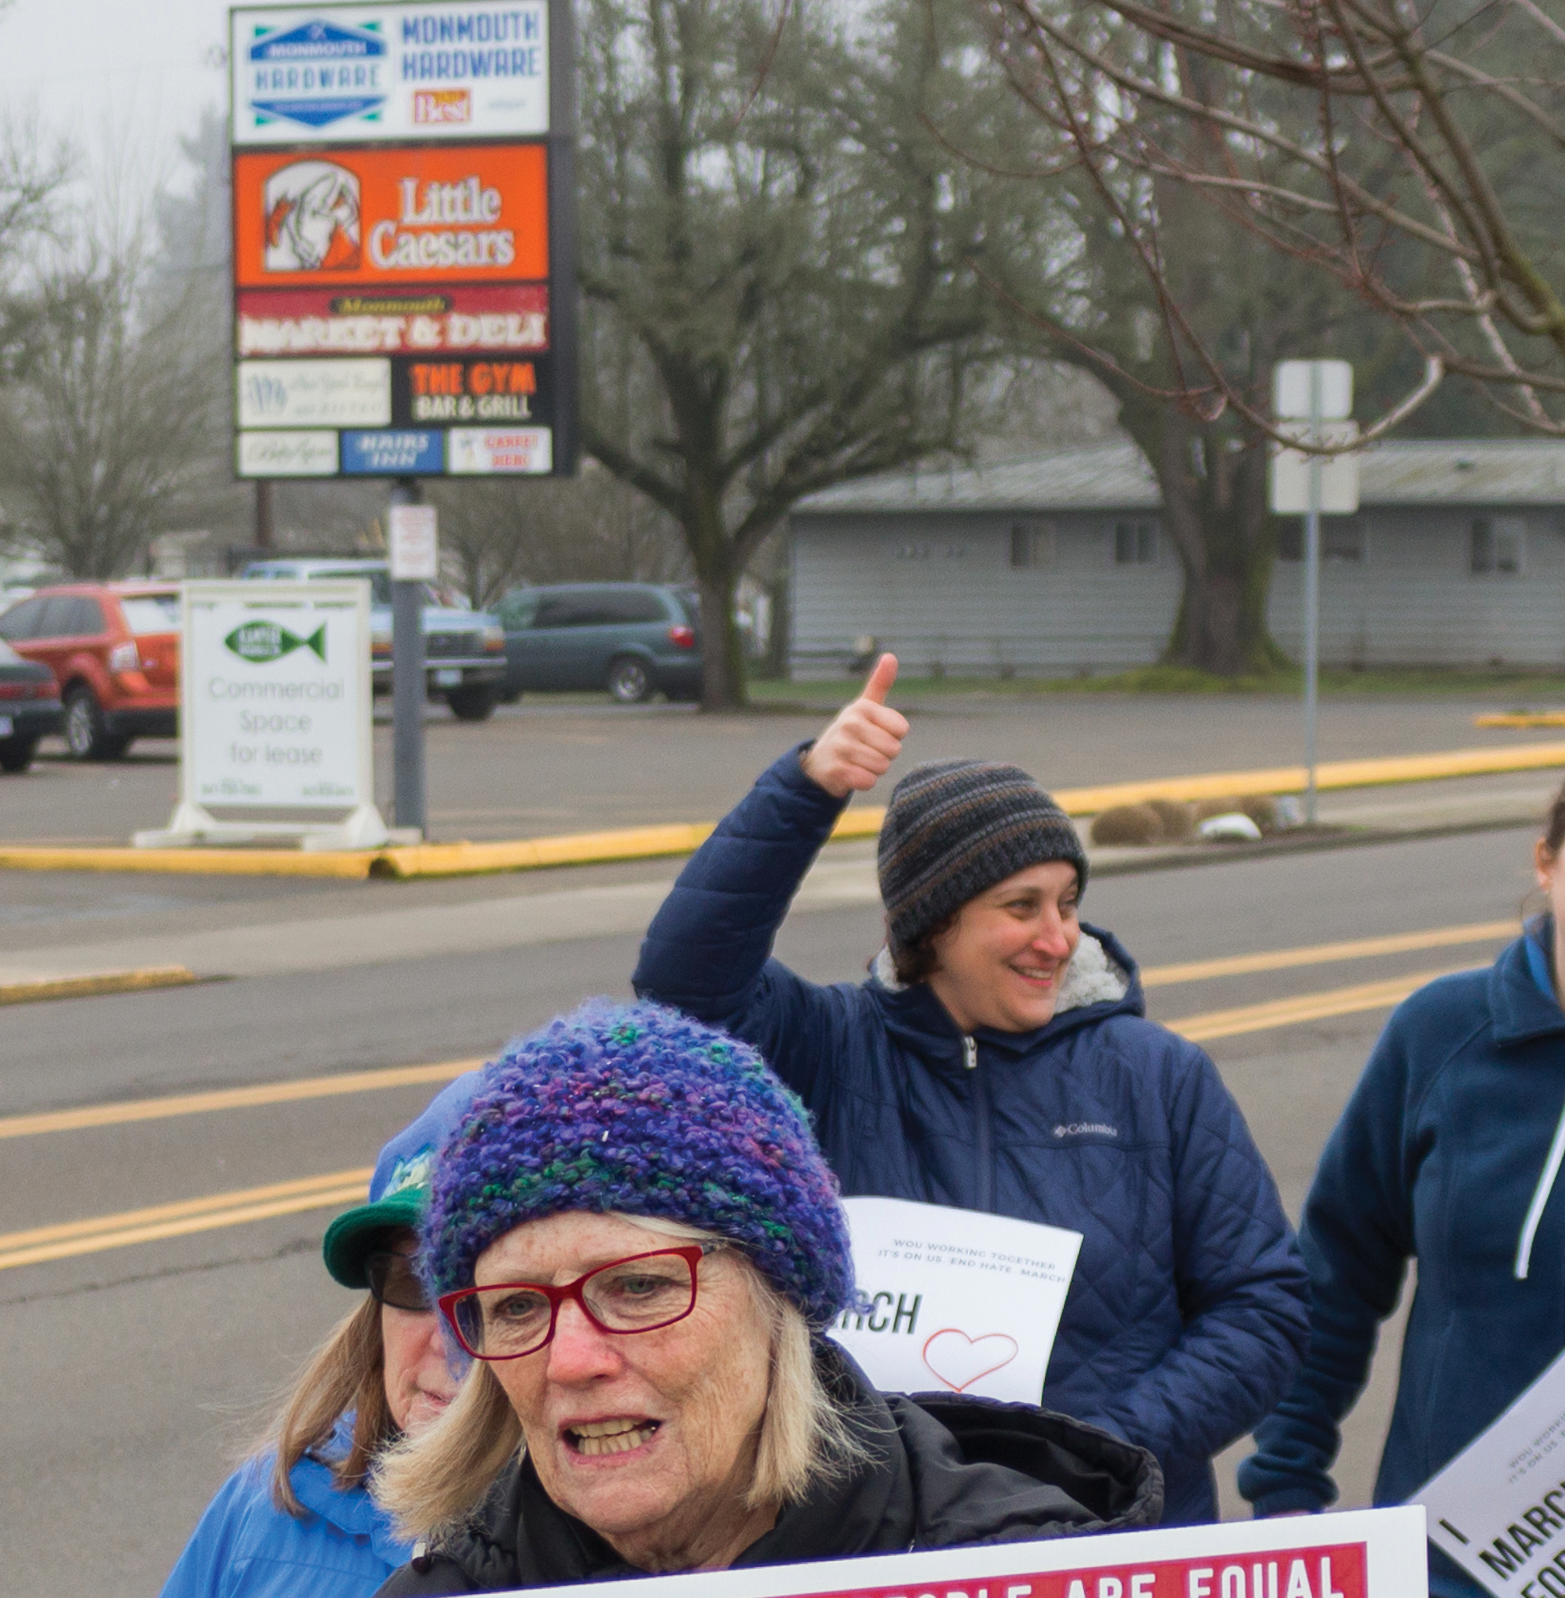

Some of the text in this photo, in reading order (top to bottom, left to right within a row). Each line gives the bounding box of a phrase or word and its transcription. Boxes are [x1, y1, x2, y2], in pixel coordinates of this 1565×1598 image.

[403, 12, 539, 44] MONMOUTH
[268, 41, 367, 57] MONMOUTH
[403, 47, 541, 80] HARDWARE
[256, 63, 379, 90] HARDWARE
[399, 176, 502, 225] Little
[370, 225, 514, 270] Caesars
[241, 315, 407, 355] MARKET
[447, 313, 547, 348] DELI
[411, 364, 463, 394] THE
[470, 363, 535, 394] GYM
[415, 396, 531, 419] BAR & GRILL
[208, 677, 345, 699] Commercial
[240, 710, 312, 734] Space
[231, 743, 323, 764] for lease
[1068, 1122, 1118, 1137] Columbia
[878, 1250, 900, 1258] IT'S
[904, 1252, 922, 1260] ON
[950, 1257, 976, 1268] END
[1021, 1269, 1066, 1283] MARCH
[893, 1239, 1056, 1270] WOU WORKING TOGETHER
[830, 1288, 923, 1335] RCH
[1439, 1519, 1470, 1546] I
